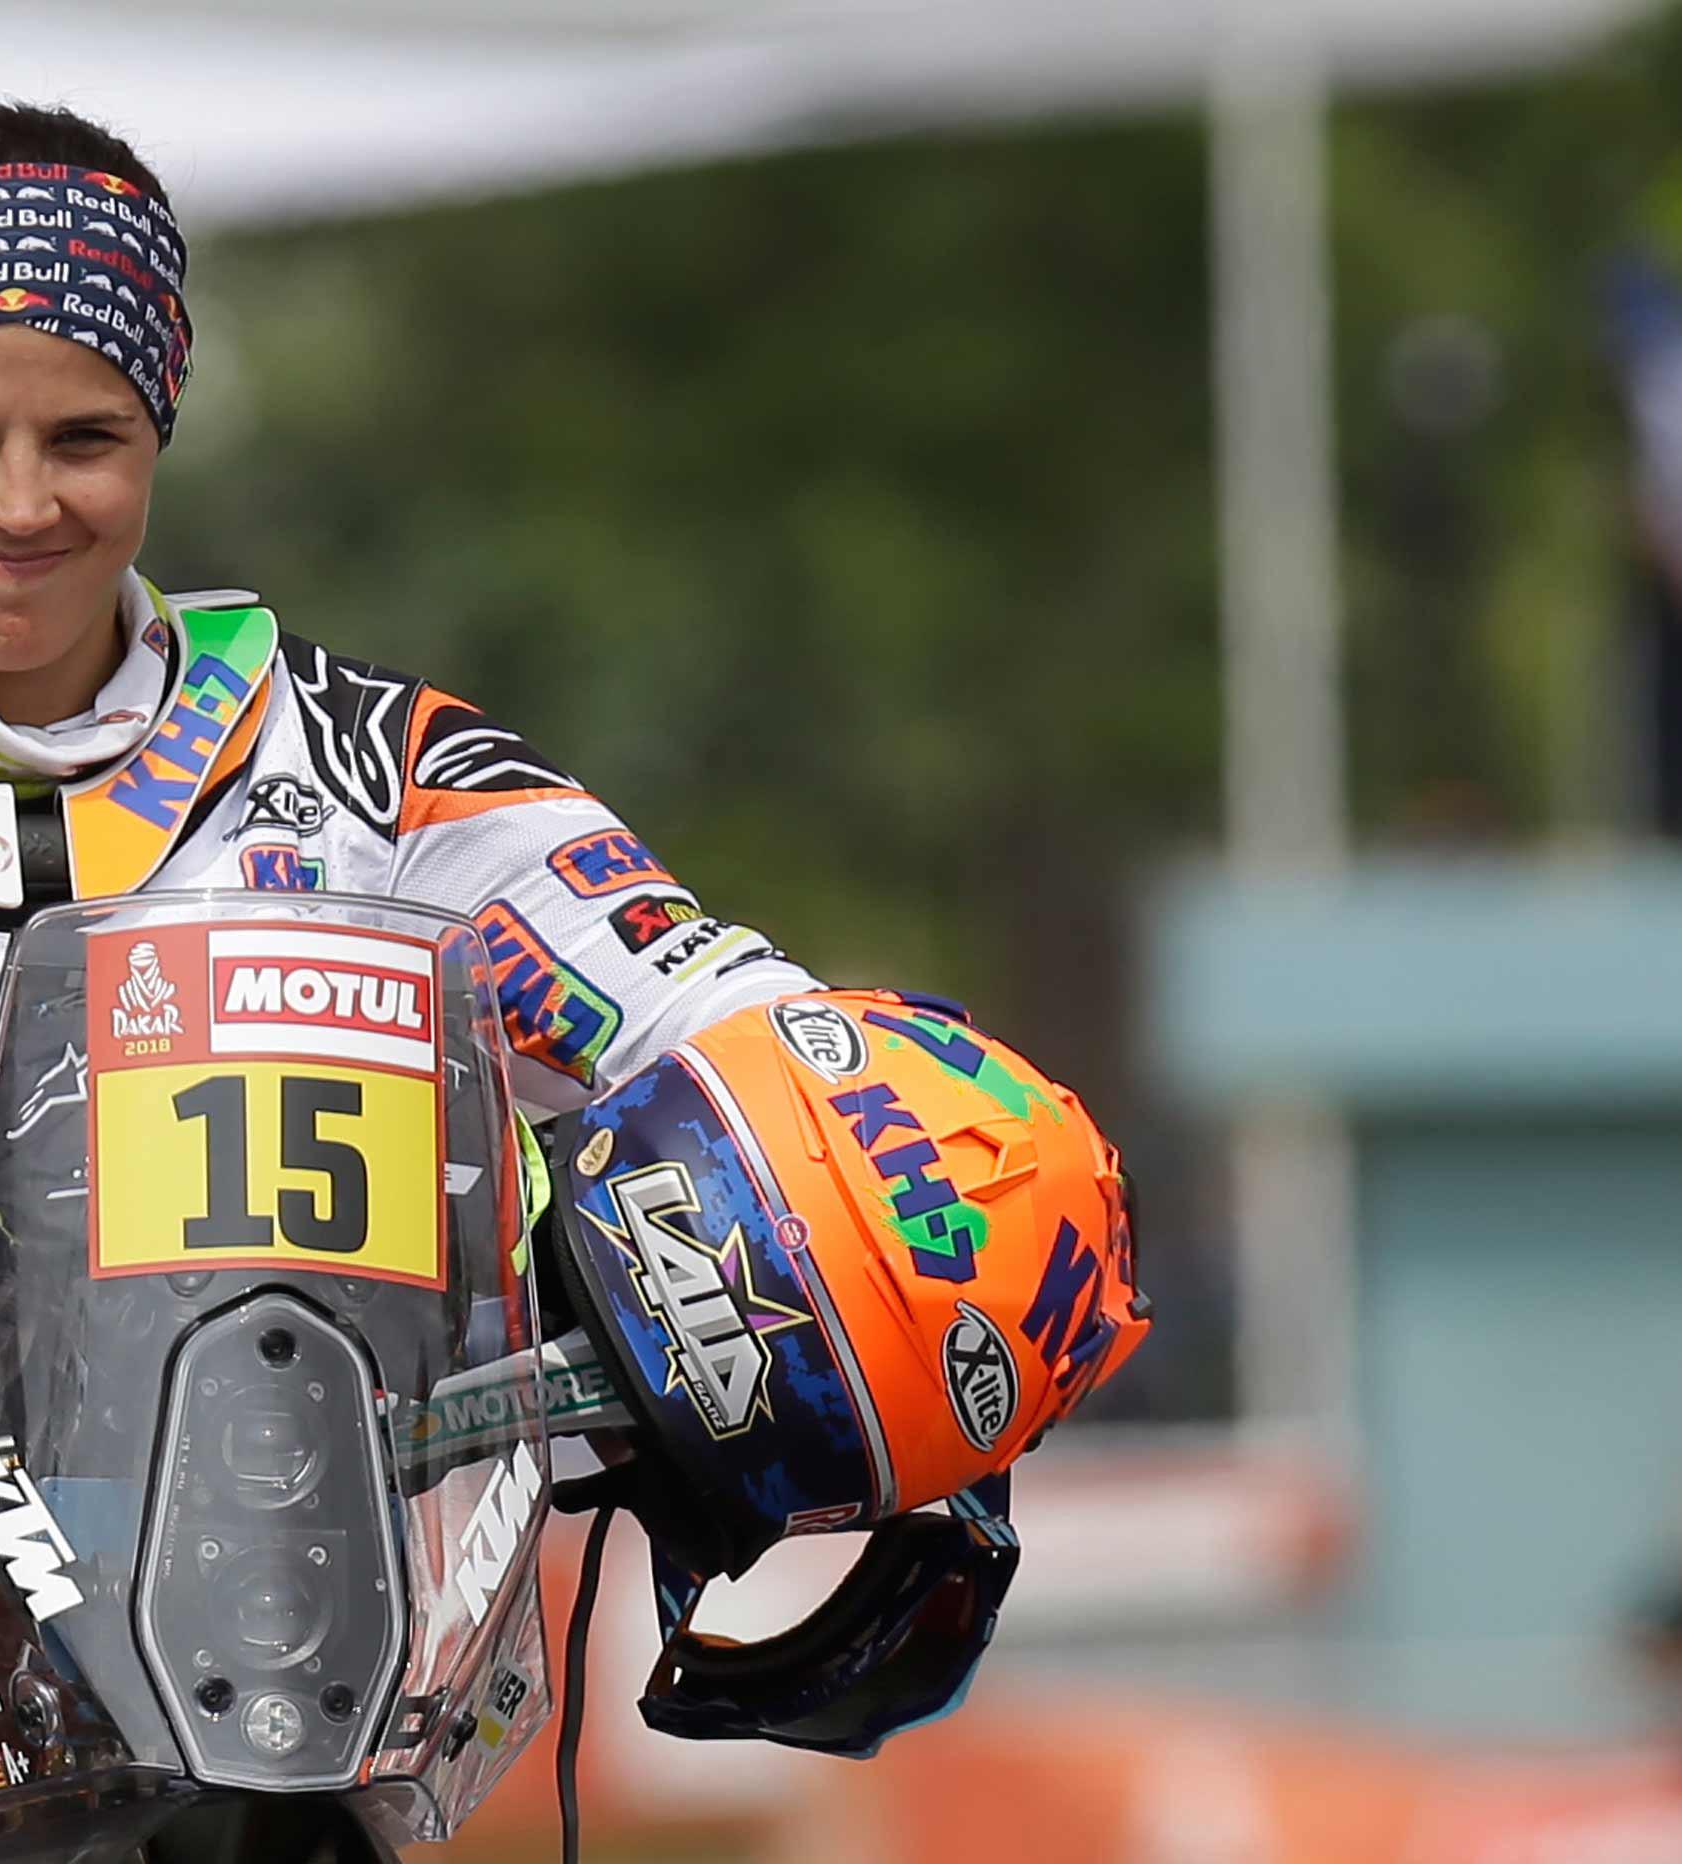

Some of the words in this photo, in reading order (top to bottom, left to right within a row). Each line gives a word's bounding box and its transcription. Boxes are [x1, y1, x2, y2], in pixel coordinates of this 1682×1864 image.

[17, 163, 68, 181] Bull
[18, 208, 72, 229] Bull
[67, 188, 115, 214] Red
[119, 203, 151, 236] Bull
[13, 262, 69, 283] Bull
[69, 239, 115, 267] Red
[63, 293, 109, 324] Red
[111, 308, 144, 346] Bull
[106, 652, 252, 832] KH-7
[112, 1003, 185, 1039] DAKAR
[225, 967, 424, 1029] MOTUL
[124, 1038, 171, 1057] 2018
[172, 1074, 370, 1253] 15
[829, 1082, 978, 1283] KH-7
[948, 1330, 1006, 1443] X-lite
[455, 1439, 543, 1627] KTM
